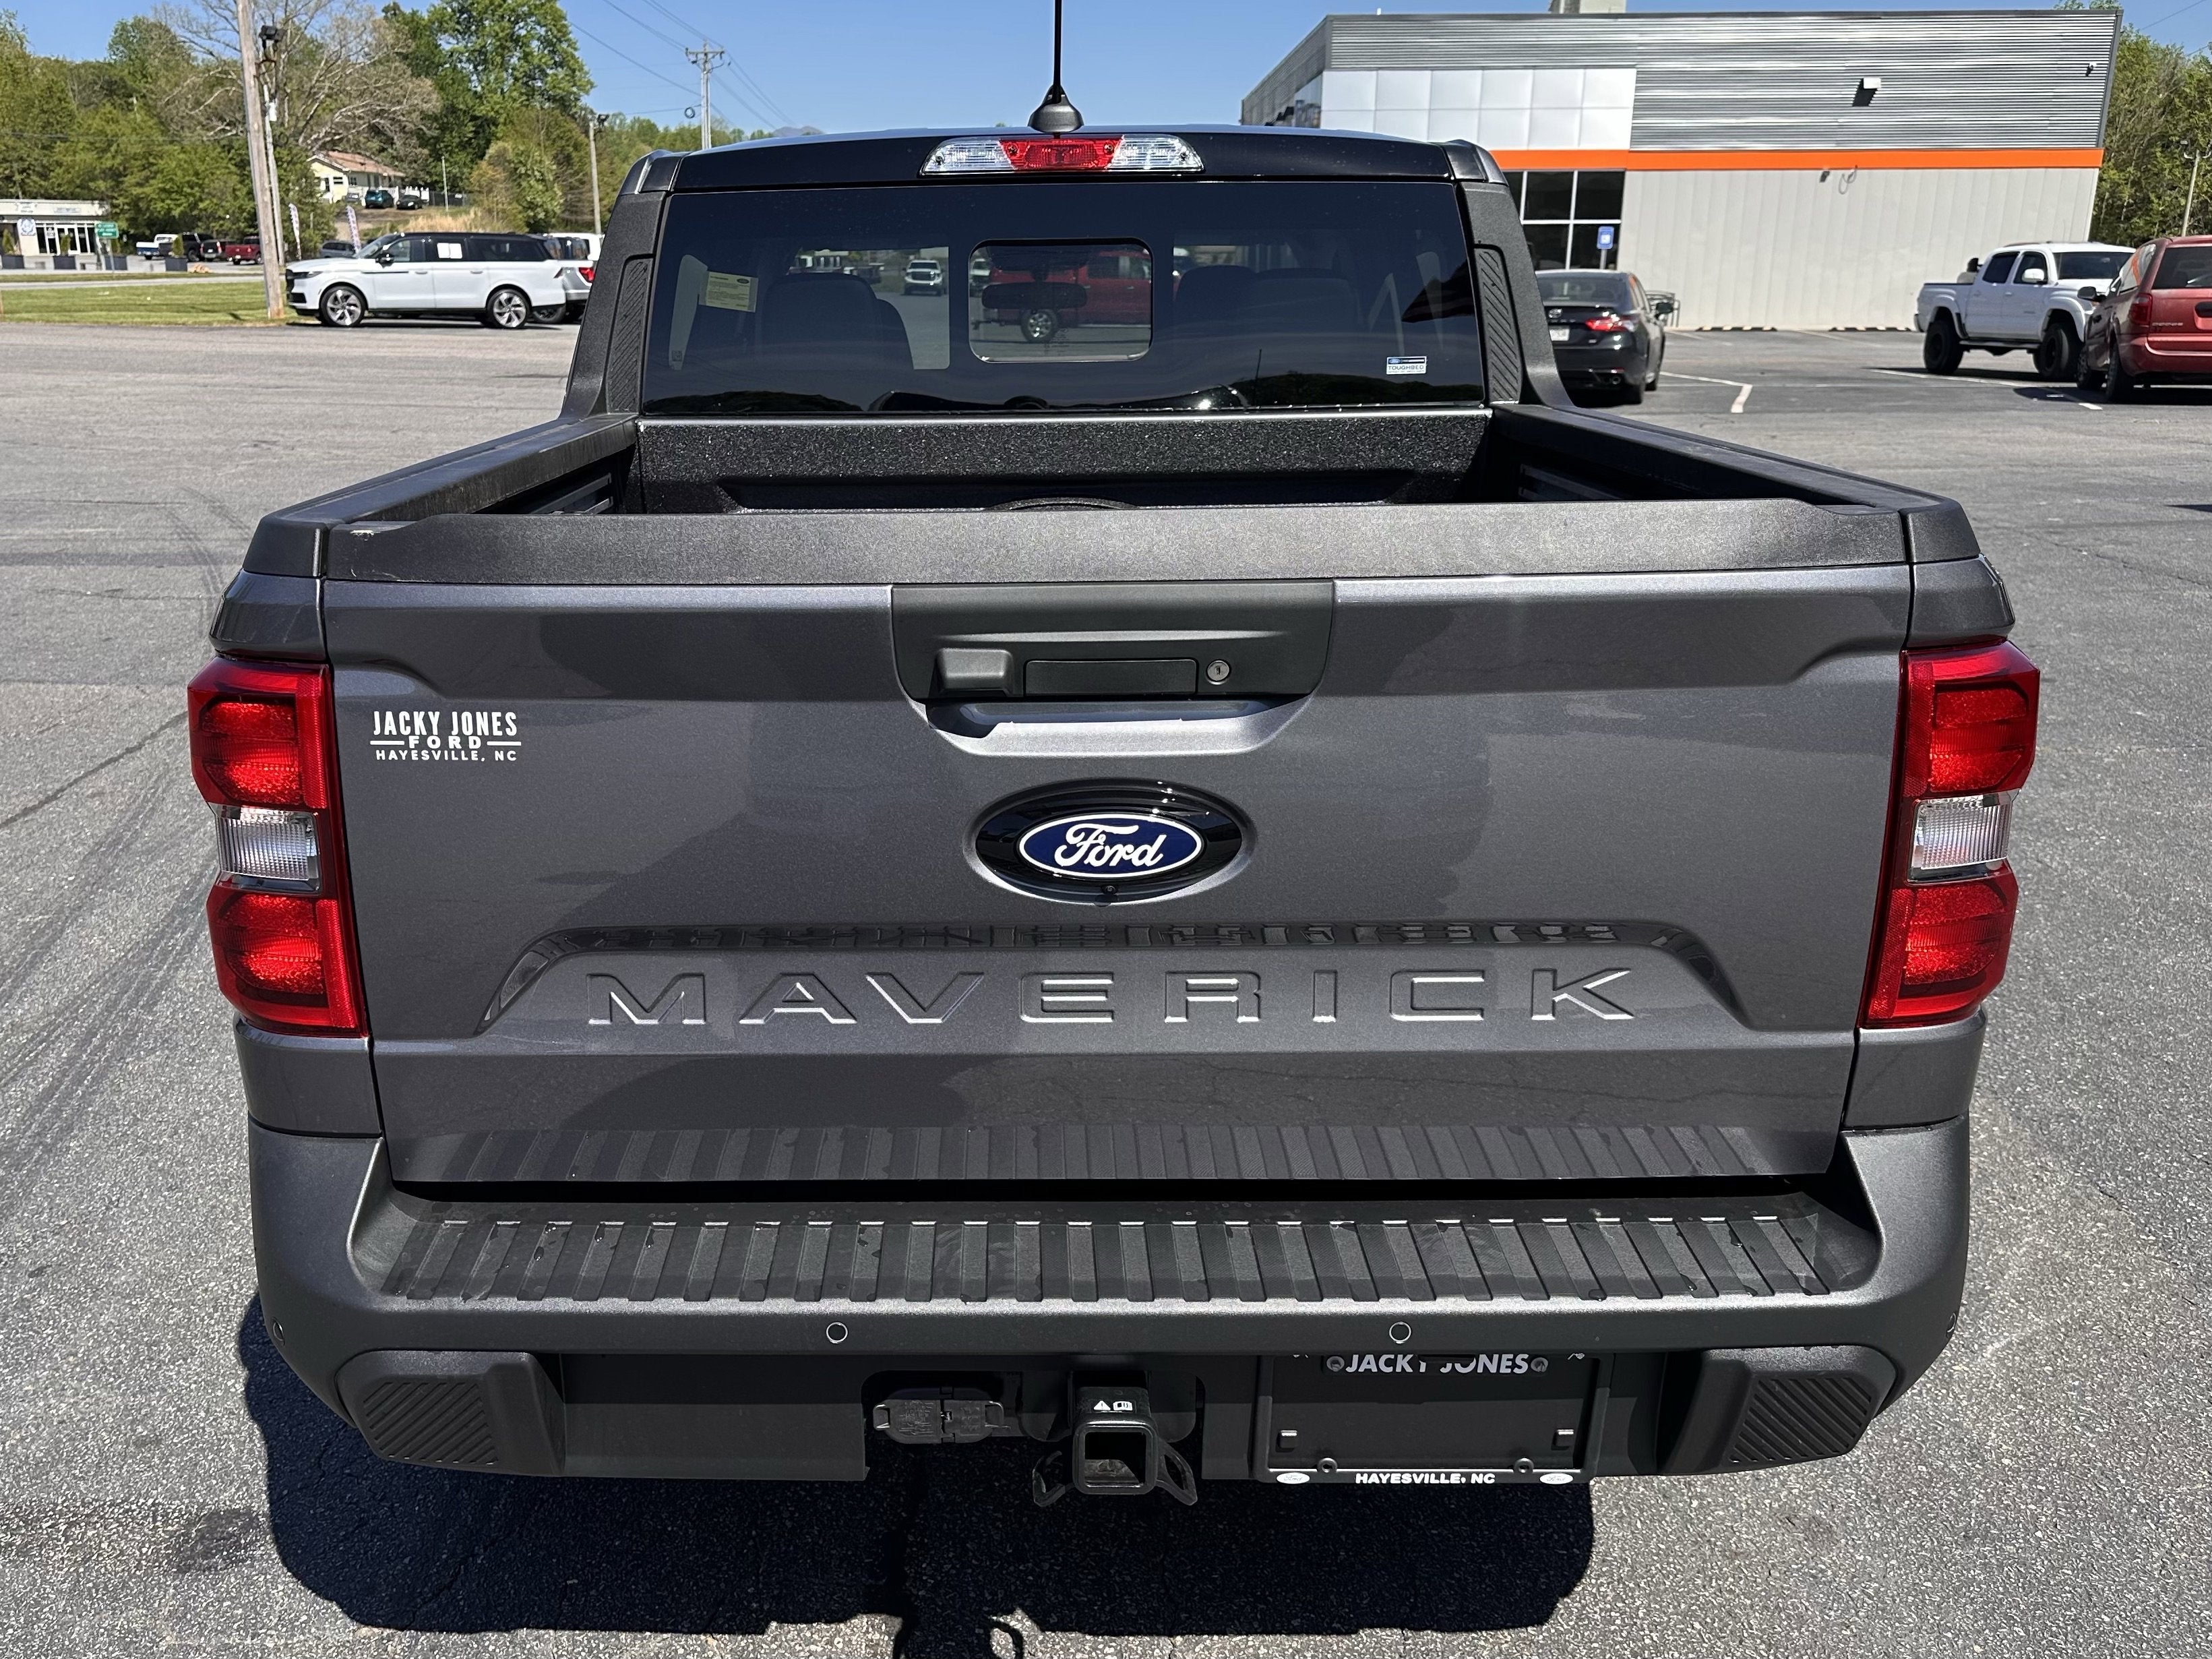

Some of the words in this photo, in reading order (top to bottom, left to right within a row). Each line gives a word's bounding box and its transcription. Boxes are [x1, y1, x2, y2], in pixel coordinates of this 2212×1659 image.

[373, 711, 440, 735] JACKY
[452, 711, 518, 736] JONES
[408, 735, 482, 749] FORD
[375, 750, 485, 762] HAYESVILLE,
[495, 750, 517, 761] NC
[1054, 823, 1167, 867] Ford
[586, 971, 1634, 1025] MAVERICK
[1355, 1473, 1467, 1484] HAYESVILLE,
[1471, 1473, 1496, 1484] NC
